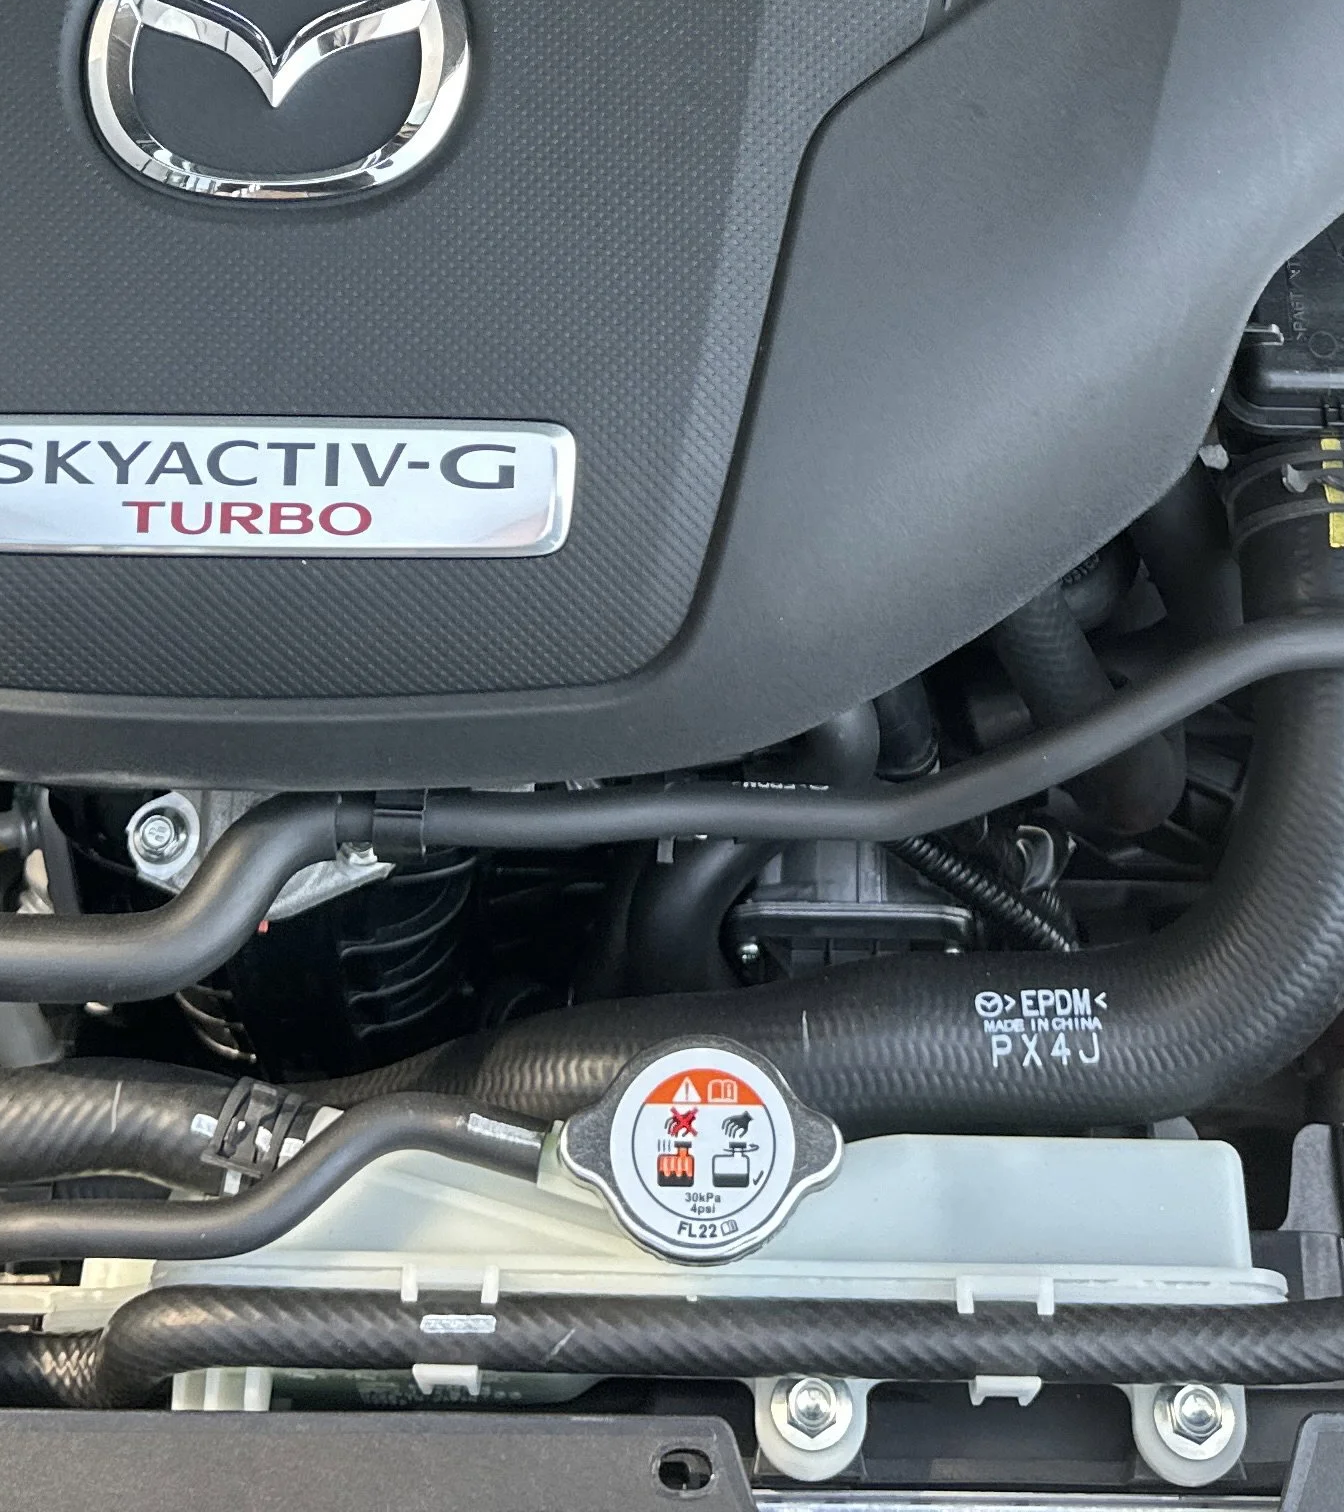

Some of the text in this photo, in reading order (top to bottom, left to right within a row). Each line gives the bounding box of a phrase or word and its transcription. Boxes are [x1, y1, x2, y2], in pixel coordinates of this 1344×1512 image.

[122, 501, 373, 536] TURBO
[983, 1016, 1103, 1033] MADE IN CHINA
[685, 1191, 721, 1203] 30kPa
[690, 1203, 716, 1215] 4psi
[677, 1220, 718, 1238] FL22
